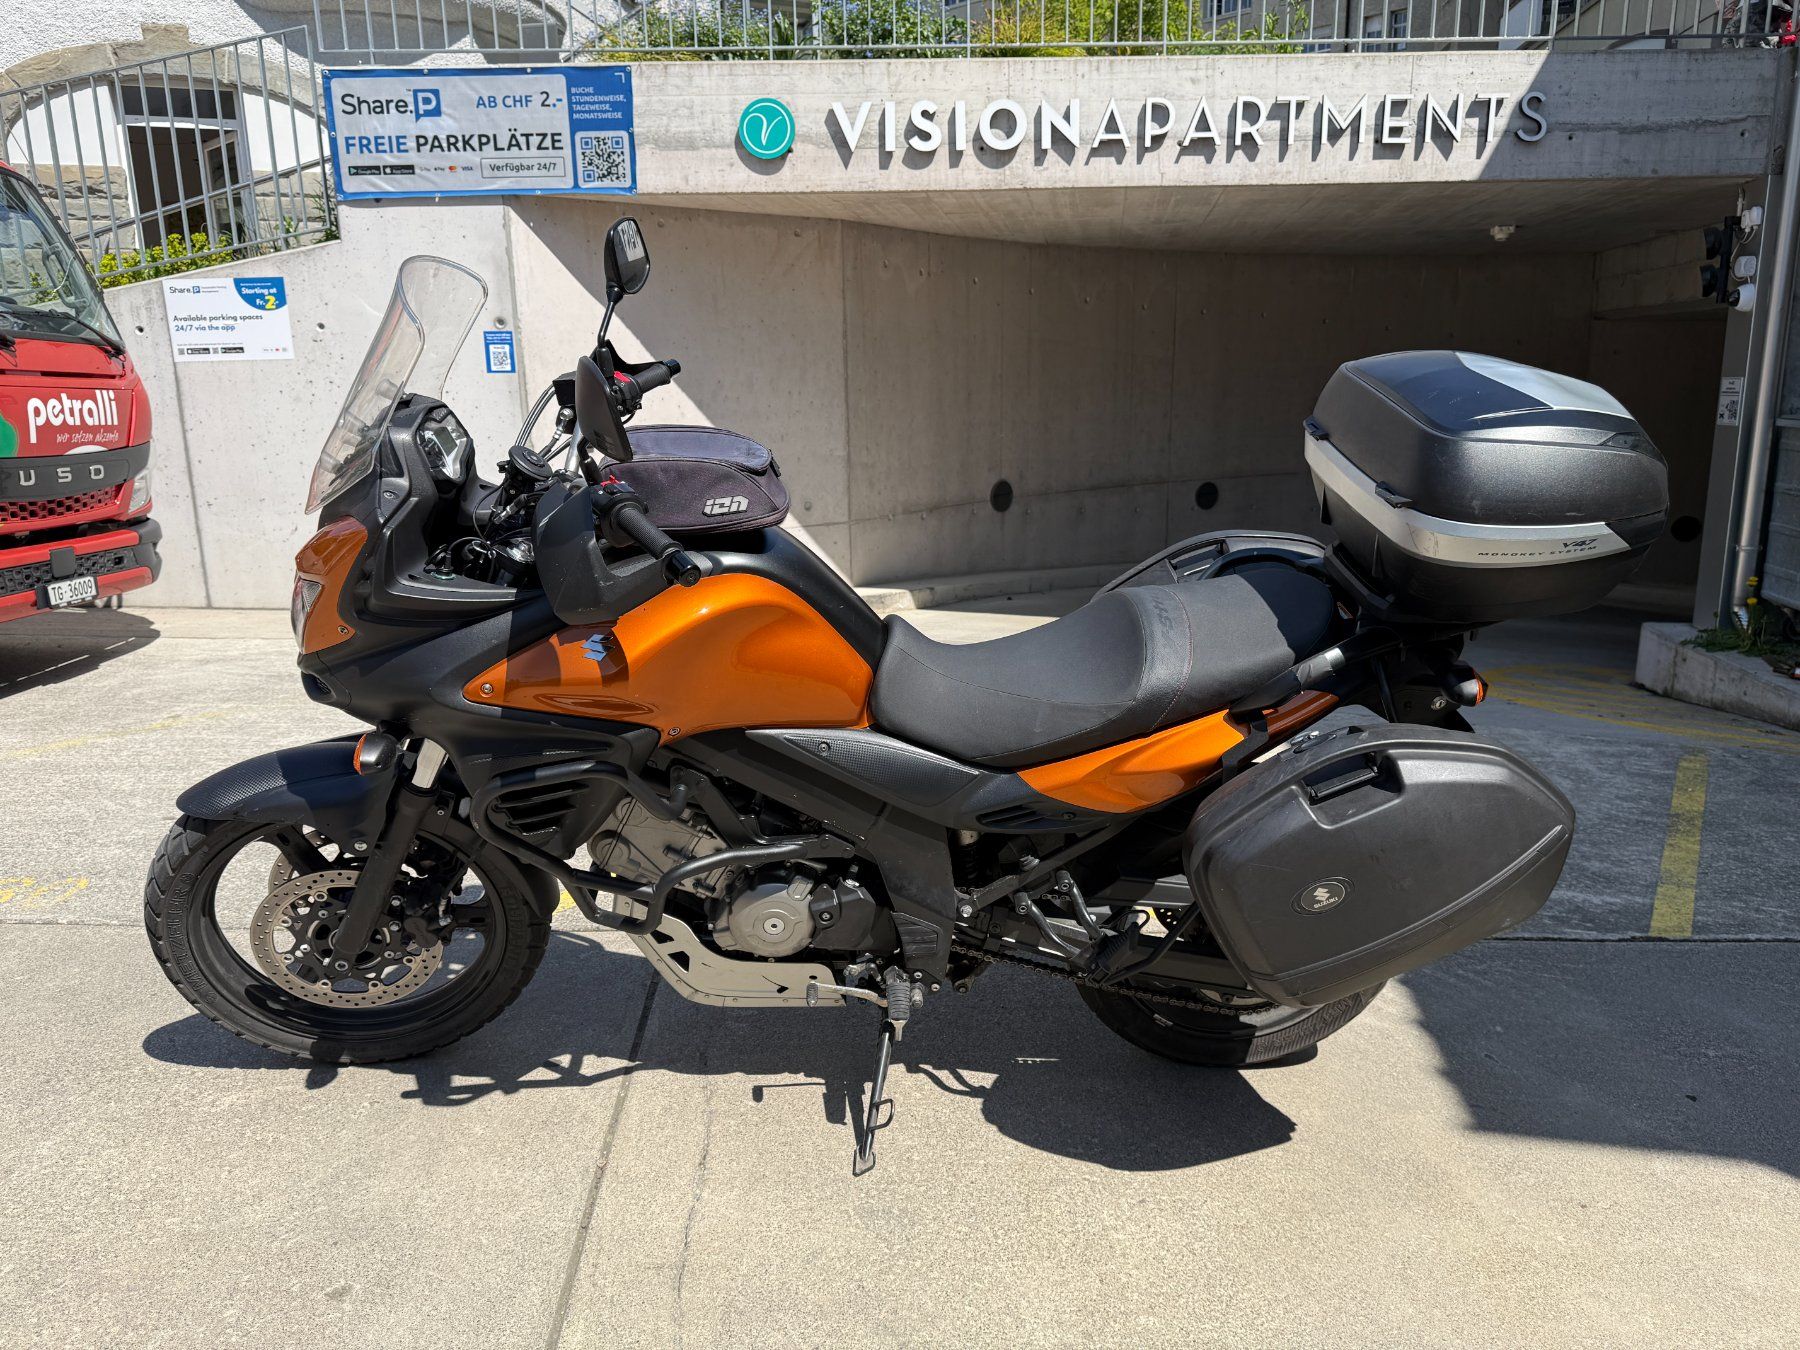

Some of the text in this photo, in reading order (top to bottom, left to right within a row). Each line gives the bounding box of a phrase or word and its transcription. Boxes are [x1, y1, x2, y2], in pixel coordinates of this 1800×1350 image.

[571, 86, 594, 94] BUCHE
[476, 96, 497, 108] AB
[502, 95, 533, 108] CHF
[571, 94, 627, 102] STUNDENWEISE,
[572, 103, 612, 111] TAGEWEISE,
[572, 111, 623, 120] MONATSWEISE
[831, 91, 1548, 153] VISIONAPARTMENTS
[344, 128, 564, 155] FREIE PARKPLÄTZE
[489, 162, 557, 173] Verfügbar 24/7
[241, 286, 269, 295] Starting
[208, 314, 238, 322] parking
[174, 324, 193, 332] 24/7
[207, 323, 220, 331] the
[27, 389, 119, 444] petralli
[1549, 545, 1598, 555] SYSTEM
[1313, 896, 1339, 909] SUZUKI
